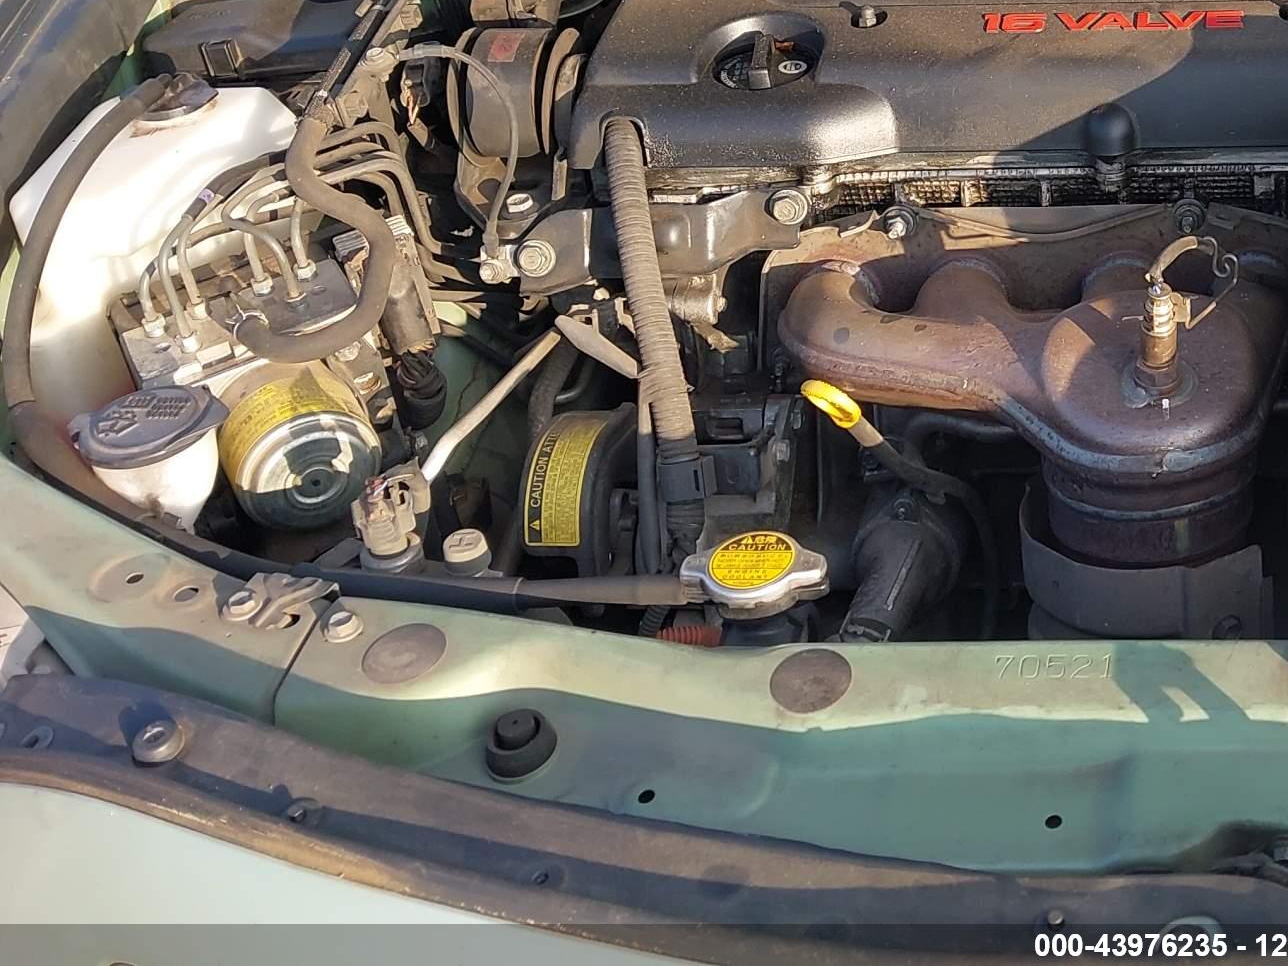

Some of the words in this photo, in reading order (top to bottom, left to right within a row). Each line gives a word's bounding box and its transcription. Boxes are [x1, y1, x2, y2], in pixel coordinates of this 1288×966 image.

[982, 13, 1047, 33] 16
[1055, 10, 1245, 31] VALVE
[529, 456, 549, 508] CAUTION
[728, 543, 787, 551] CAUTION
[994, 653, 1112, 680] 70521
